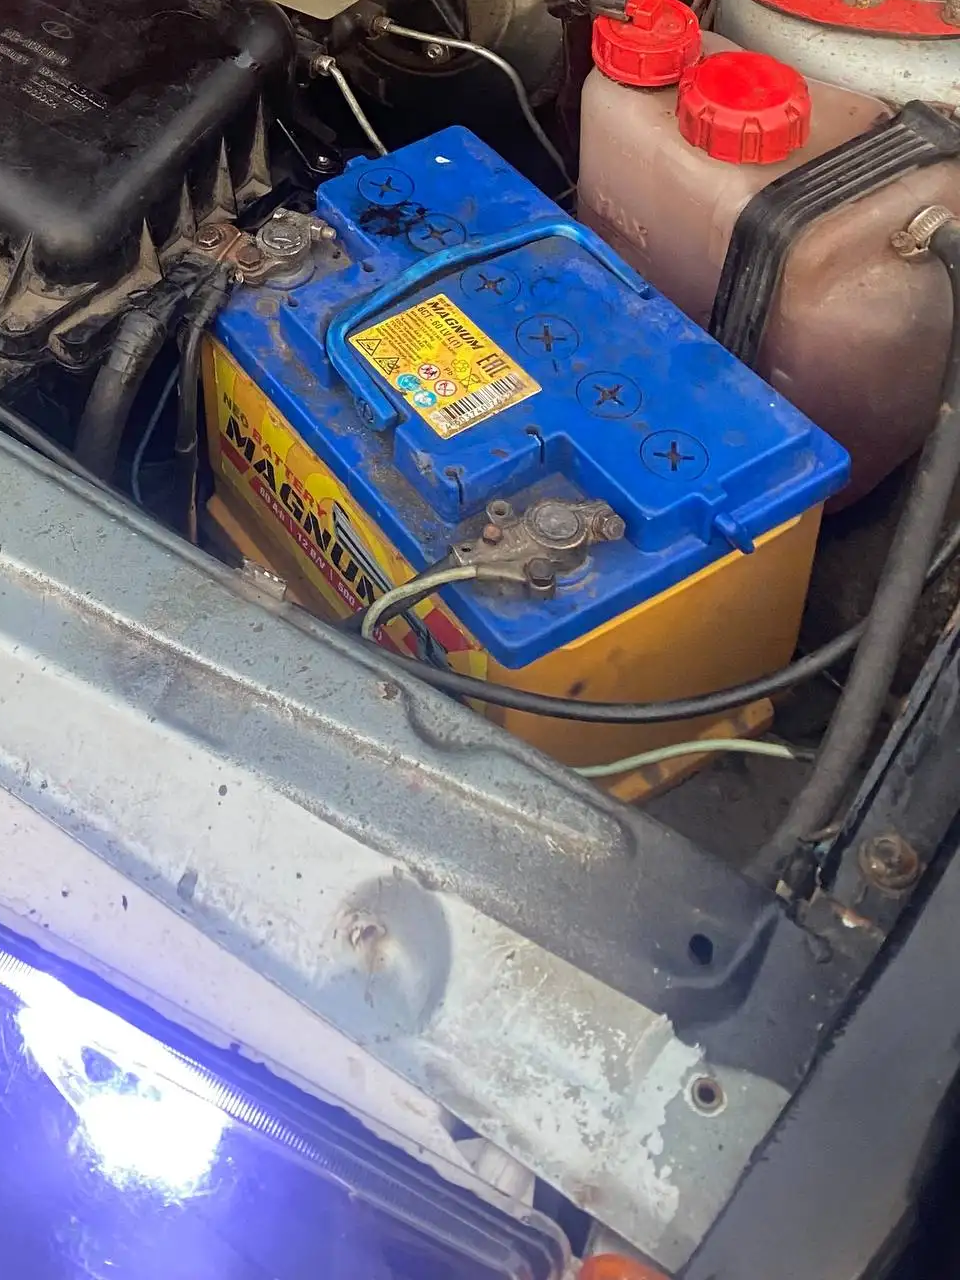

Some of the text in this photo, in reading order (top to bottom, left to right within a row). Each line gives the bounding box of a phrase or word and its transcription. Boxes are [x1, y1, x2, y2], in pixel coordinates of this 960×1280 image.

[427, 300, 485, 350] MAGNUM
[223, 392, 327, 517] NEO BATTERY
[296, 532, 309, 549] 12
